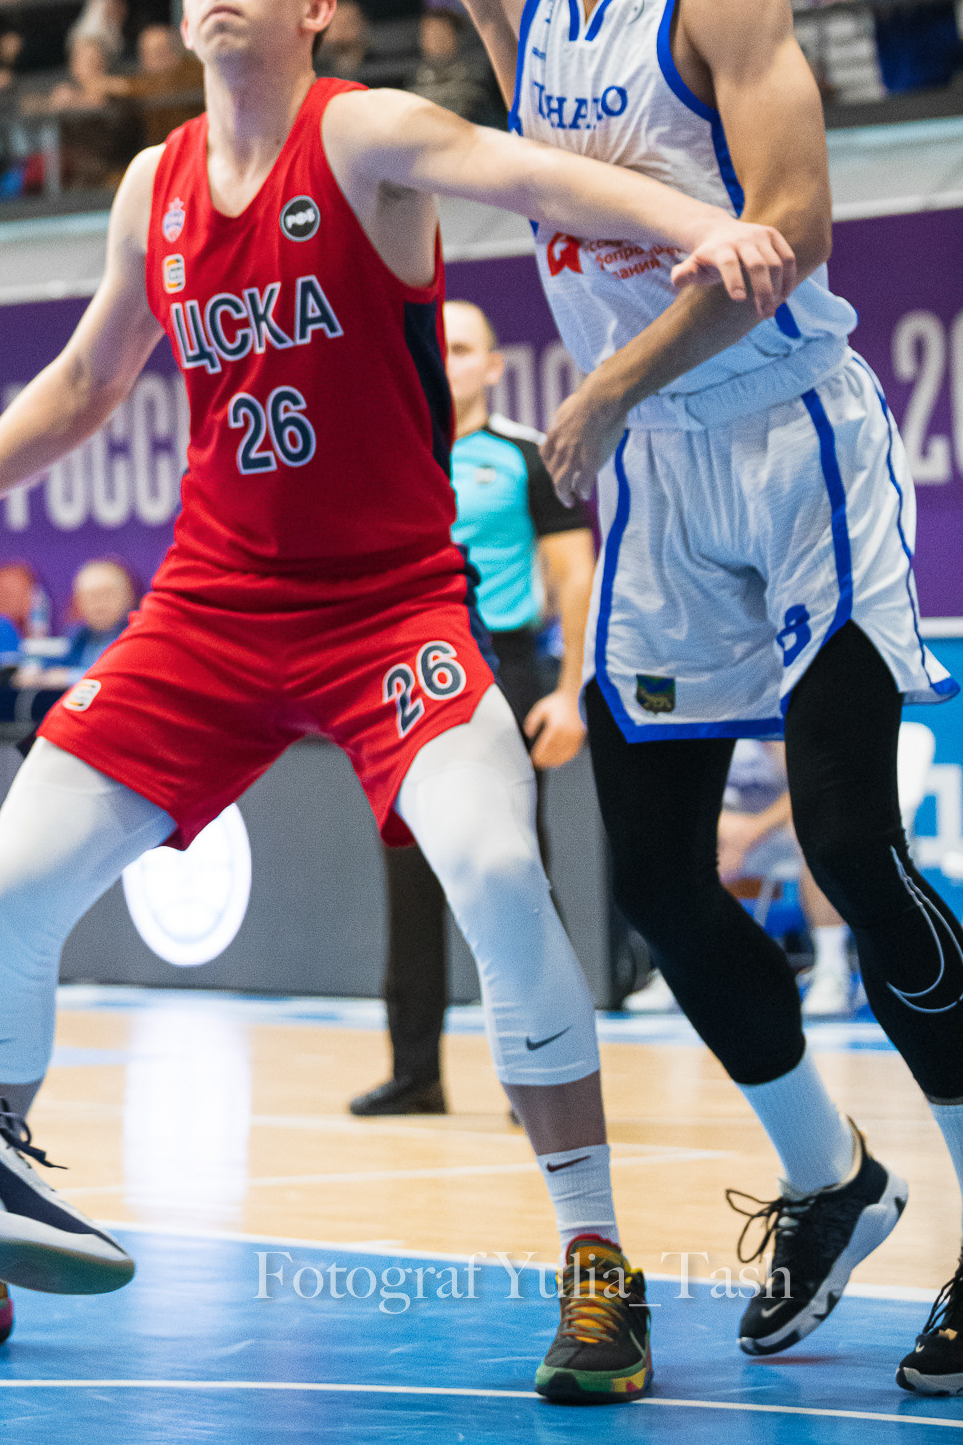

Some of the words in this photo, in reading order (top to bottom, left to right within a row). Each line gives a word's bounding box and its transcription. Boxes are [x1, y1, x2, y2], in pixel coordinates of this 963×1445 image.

[169, 274, 345, 375] ЦСКА
[227, 384, 318, 476] 26
[381, 639, 468, 739] 26
